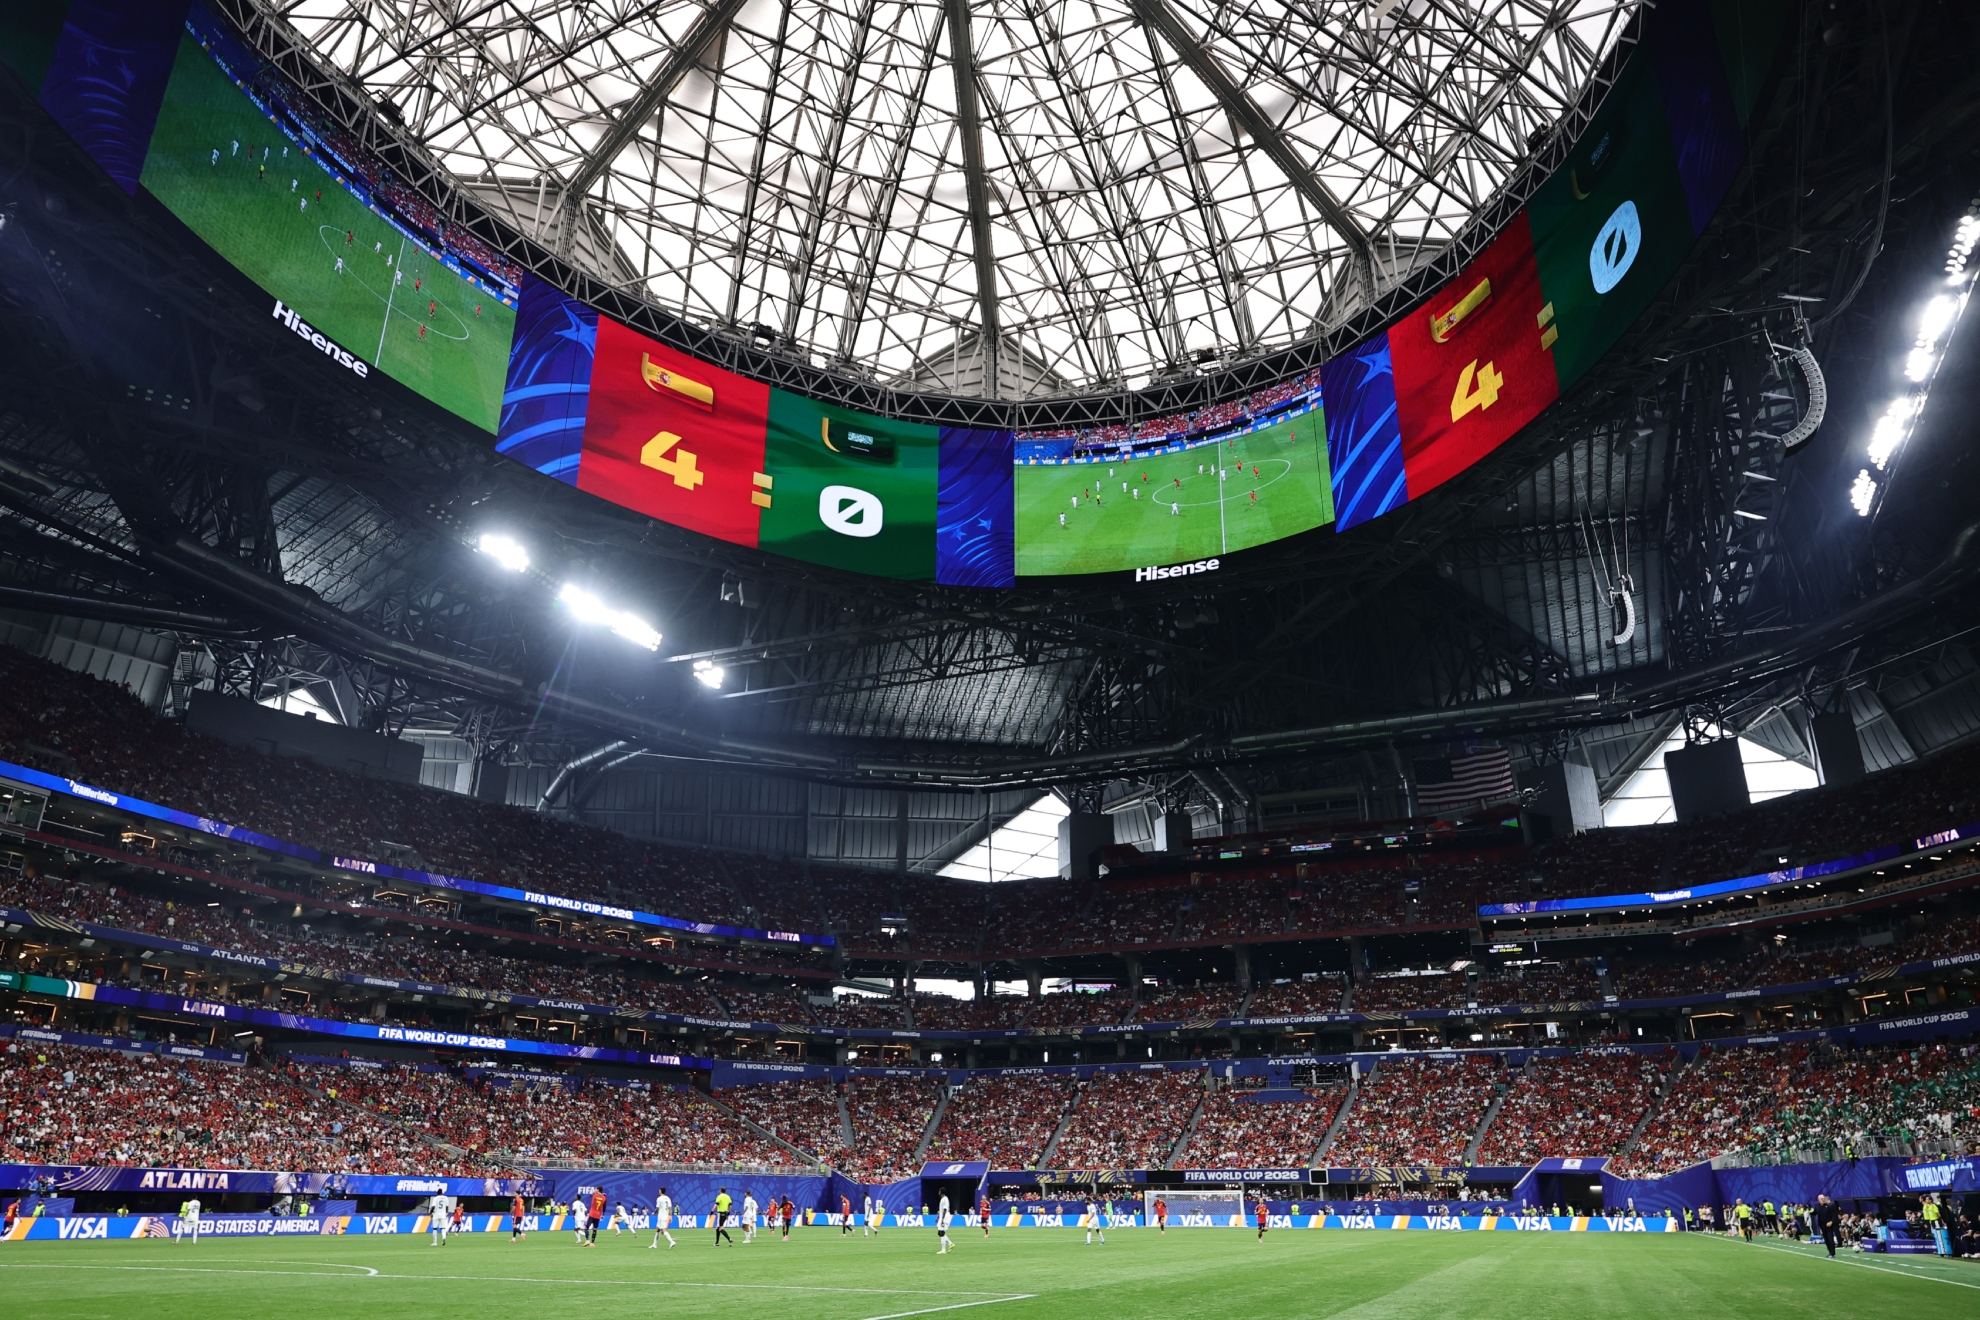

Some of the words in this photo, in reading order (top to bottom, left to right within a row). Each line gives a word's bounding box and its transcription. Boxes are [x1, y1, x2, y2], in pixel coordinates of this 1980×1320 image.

[215, 53, 231, 75] VISA
[249, 91, 264, 111] VISA
[287, 109, 301, 125] FIFA
[300, 121, 322, 144] WORLD
[321, 142, 334, 156] CUP
[316, 156, 331, 174] VISA
[350, 185, 364, 202] VISA
[395, 205, 423, 229] ATLANTA
[446, 260, 462, 275] VISA
[482, 284, 497, 298] VISA
[272, 300, 368, 378] Hisense
[1450, 358, 1504, 423] 4
[1289, 408, 1304, 417] VISA
[1206, 420, 1232, 431] ATLANTA
[1257, 421, 1272, 429] VISA
[639, 430, 704, 491] 4
[819, 485, 883, 538] 0
[1135, 558, 1220, 582] Hisense
[1916, 828, 1960, 850] LANTA
[333, 856, 376, 873] LANTA
[525, 892, 546, 904] FIFA
[547, 896, 581, 910] WORLD
[582, 902, 601, 913] CUP
[601, 906, 634, 919] 2026
[767, 931, 800, 941] LANTA
[211, 949, 266, 966] ATLANTA
[1933, 959, 1951, 968] FIFA
[1951, 952, 1980, 965] WORLD
[183, 1000, 225, 1016] LANTA
[538, 999, 585, 1011] ATLANTA
[1447, 1007, 1502, 1016] ATLANTA
[696, 1018, 715, 1026] WORLD
[1304, 1015, 1328, 1023] 2026
[1879, 1021, 1896, 1030] FIFA
[1895, 1017, 1923, 1029] WORLD
[1923, 1015, 1940, 1024] CUP
[1940, 1011, 1969, 1022] 2026
[1098, 1024, 1144, 1032] ATLANTA
[378, 1027, 403, 1039] FIFA
[405, 1029, 445, 1043] WORLD
[446, 1034, 469, 1045] CUP
[469, 1037, 507, 1049] 2026
[650, 1054, 680, 1065] LANTA
[733, 1062, 747, 1070] FIFA
[140, 1171, 229, 1189] ATLANTA
[1185, 1171, 1205, 1180] FIFA
[1206, 1171, 1242, 1180] WORLD
[1243, 1171, 1263, 1180] CUP
[1264, 1170, 1300, 1180] 2026
[1905, 1169, 1920, 1189] FIFA
[1917, 1166, 1939, 1188] WORLD
[396, 1180, 448, 1192] #FIFAWorldCup
[438, 1200, 444, 1210] 5
[595, 1201, 602, 1211] 7
[215, 1220, 256, 1233] STATES
[257, 1220, 272, 1232] OF
[272, 1219, 319, 1232] AMERICA
[363, 1216, 398, 1233] VISA
[519, 1216, 538, 1230] ISA
[626, 1215, 650, 1229] VISA
[678, 1215, 697, 1228] VISA
[894, 1214, 924, 1226] VISA
[1032, 1214, 1063, 1226] VISA
[1179, 1215, 1213, 1226] VISA
[1337, 1215, 1375, 1229] VISA
[1422, 1216, 1462, 1230] VISA
[1510, 1217, 1552, 1231] VISA
[1603, 1217, 1647, 1231] VISA
[55, 1218, 108, 1238] VISA
